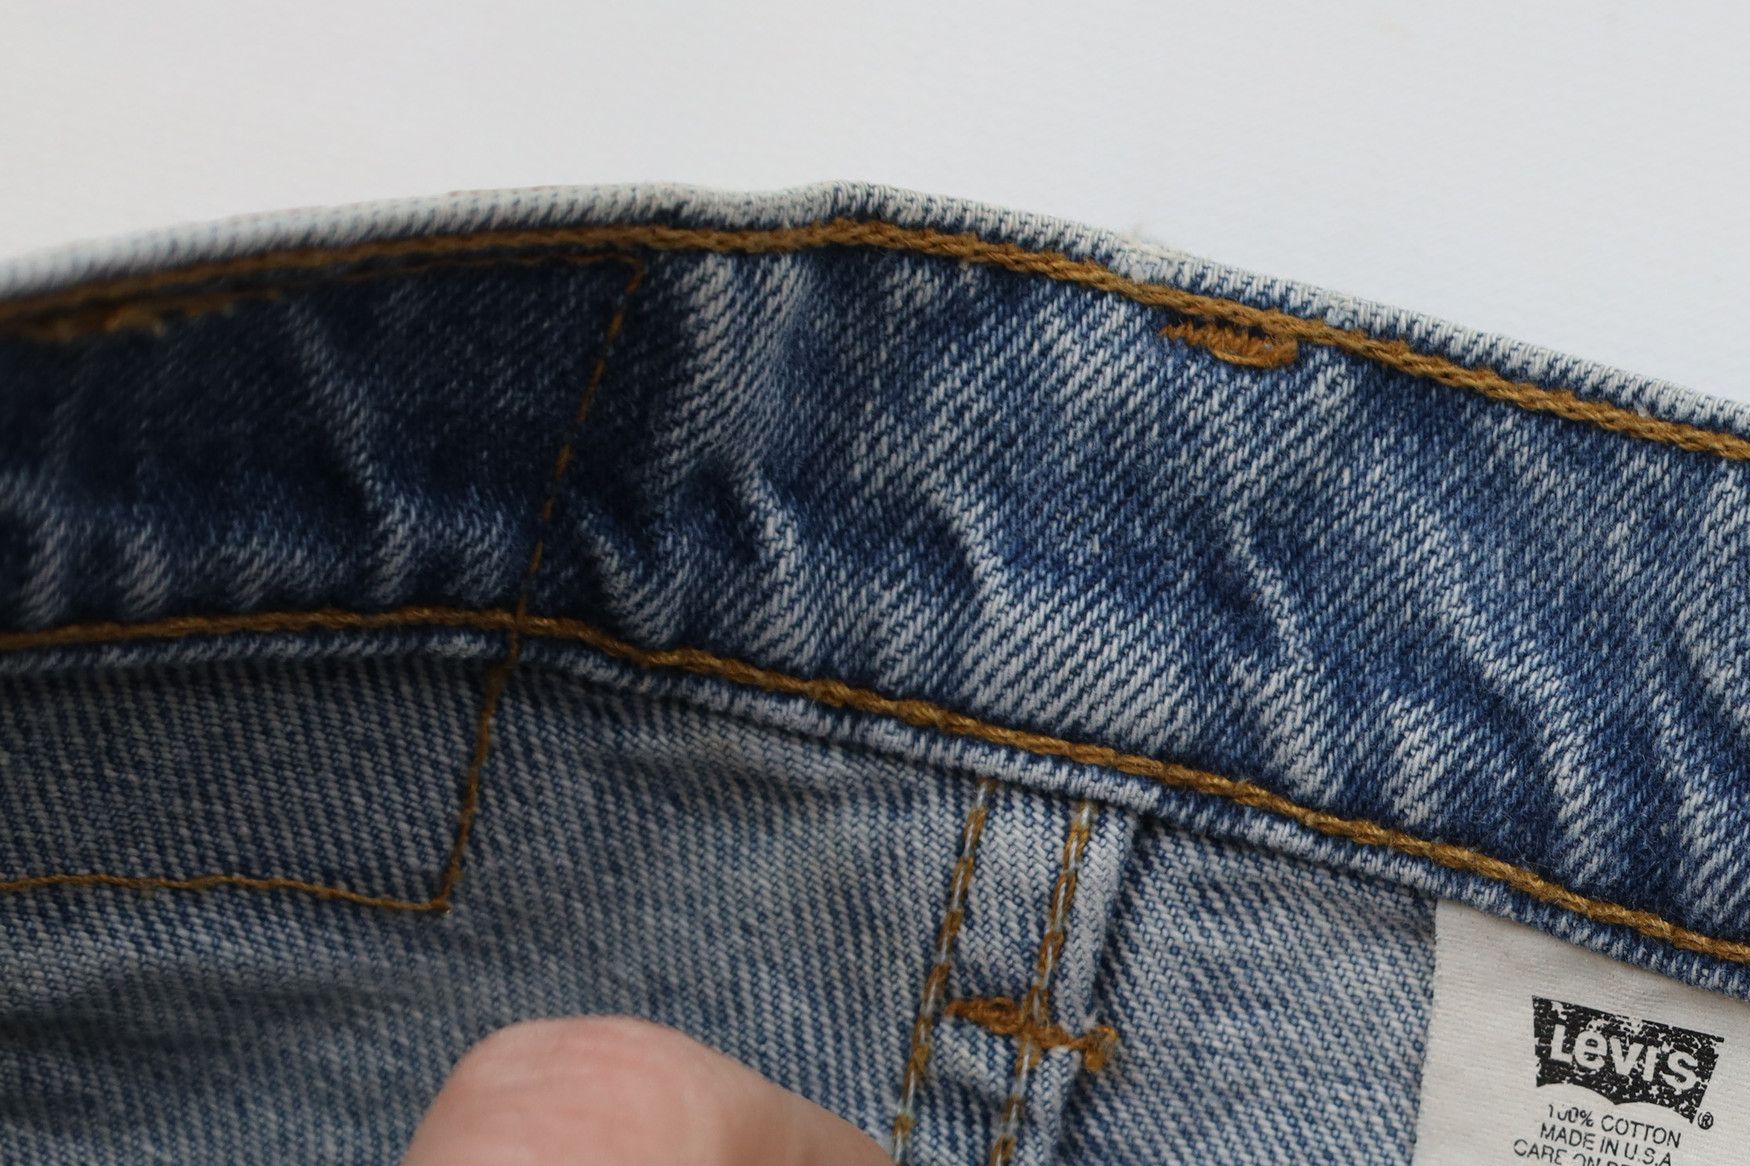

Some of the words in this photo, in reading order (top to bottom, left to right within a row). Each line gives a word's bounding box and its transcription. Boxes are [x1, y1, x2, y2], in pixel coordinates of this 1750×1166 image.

[1540, 1122, 1596, 1151] MADE
[1600, 1138, 1619, 1157] IN
[1548, 1104, 1594, 1128] 100%
[1600, 1114, 1682, 1149] COTTON
[1513, 1138, 1567, 1166] CARE
